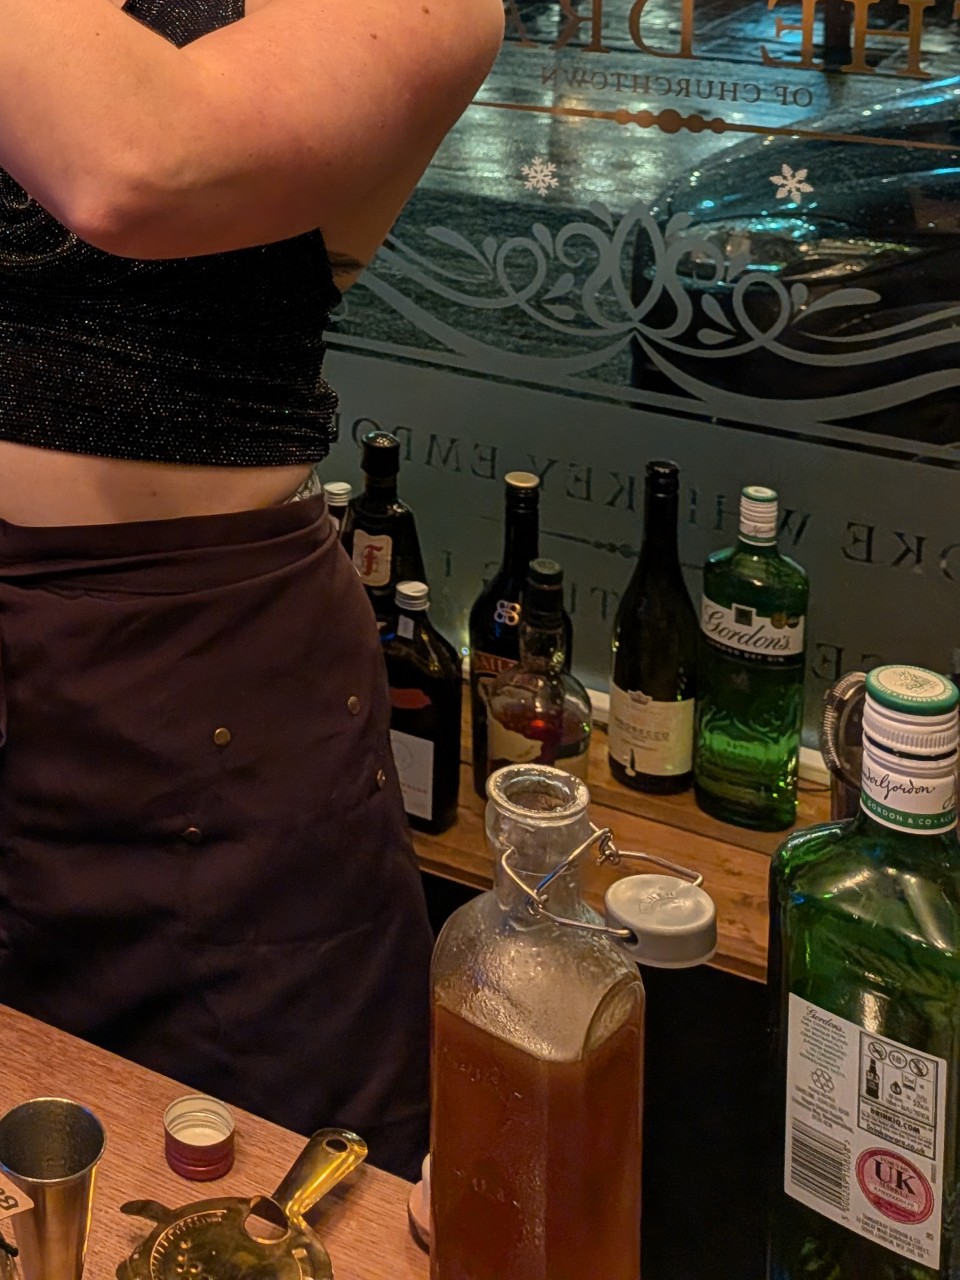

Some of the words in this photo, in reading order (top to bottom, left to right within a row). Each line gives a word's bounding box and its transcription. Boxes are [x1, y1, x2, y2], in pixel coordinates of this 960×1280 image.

[702, 603, 792, 651] Gordon's
[866, 799, 904, 824] GORDON
[872, 1157, 916, 1197] UK
